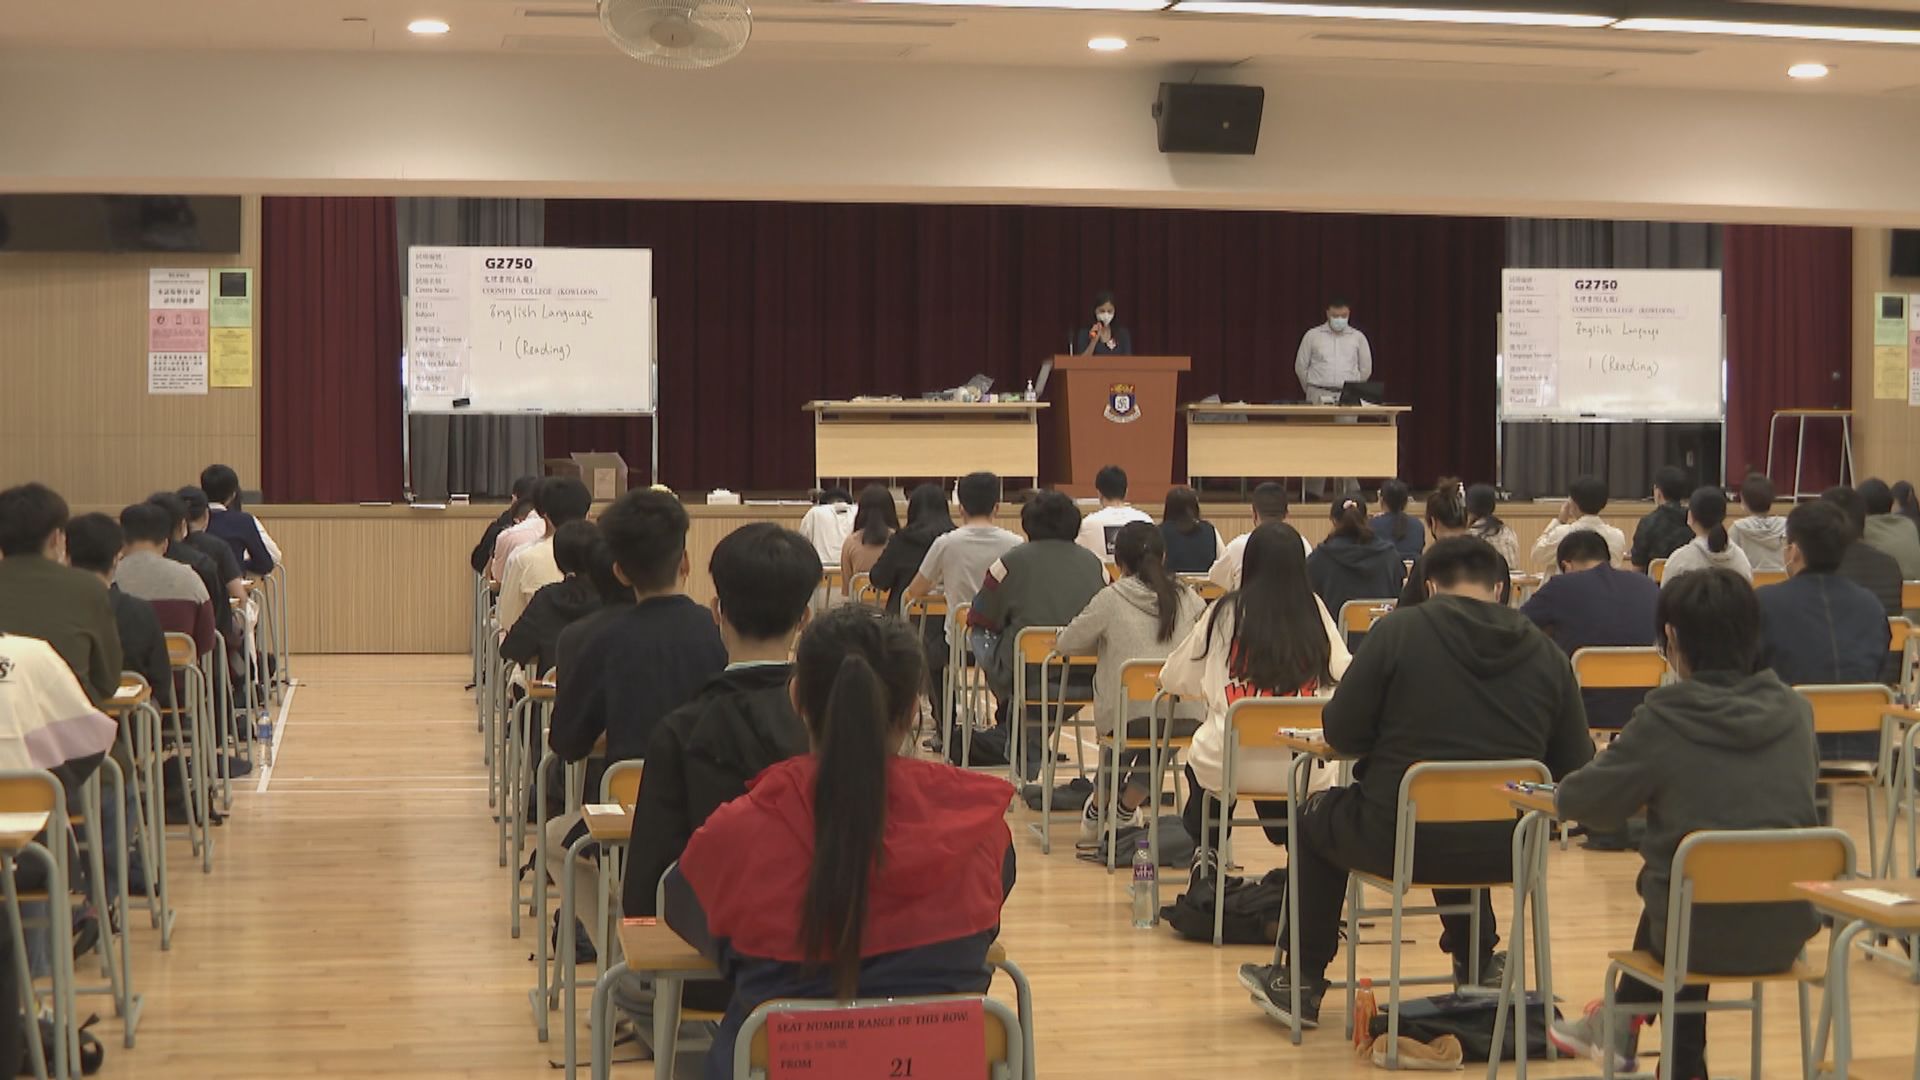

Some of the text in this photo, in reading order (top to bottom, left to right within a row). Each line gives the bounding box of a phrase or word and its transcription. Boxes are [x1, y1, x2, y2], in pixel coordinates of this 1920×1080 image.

[485, 258, 533, 269] G2750
[1575, 280, 1618, 290] G2750
[489, 304, 594, 325] English Language
[1575, 321, 1613, 338] English
[515, 336, 571, 361] (Reading)
[1601, 353, 1660, 379] (Reading)
[777, 1022, 802, 1033] SEAT
[806, 1019, 855, 1032] NUMBER
[858, 1017, 895, 1029] RANGE
[898, 1015, 912, 1025] OF
[915, 1013, 939, 1025] THIS
[780, 1059, 812, 1069] FROM
[890, 1056, 913, 1078] 21
